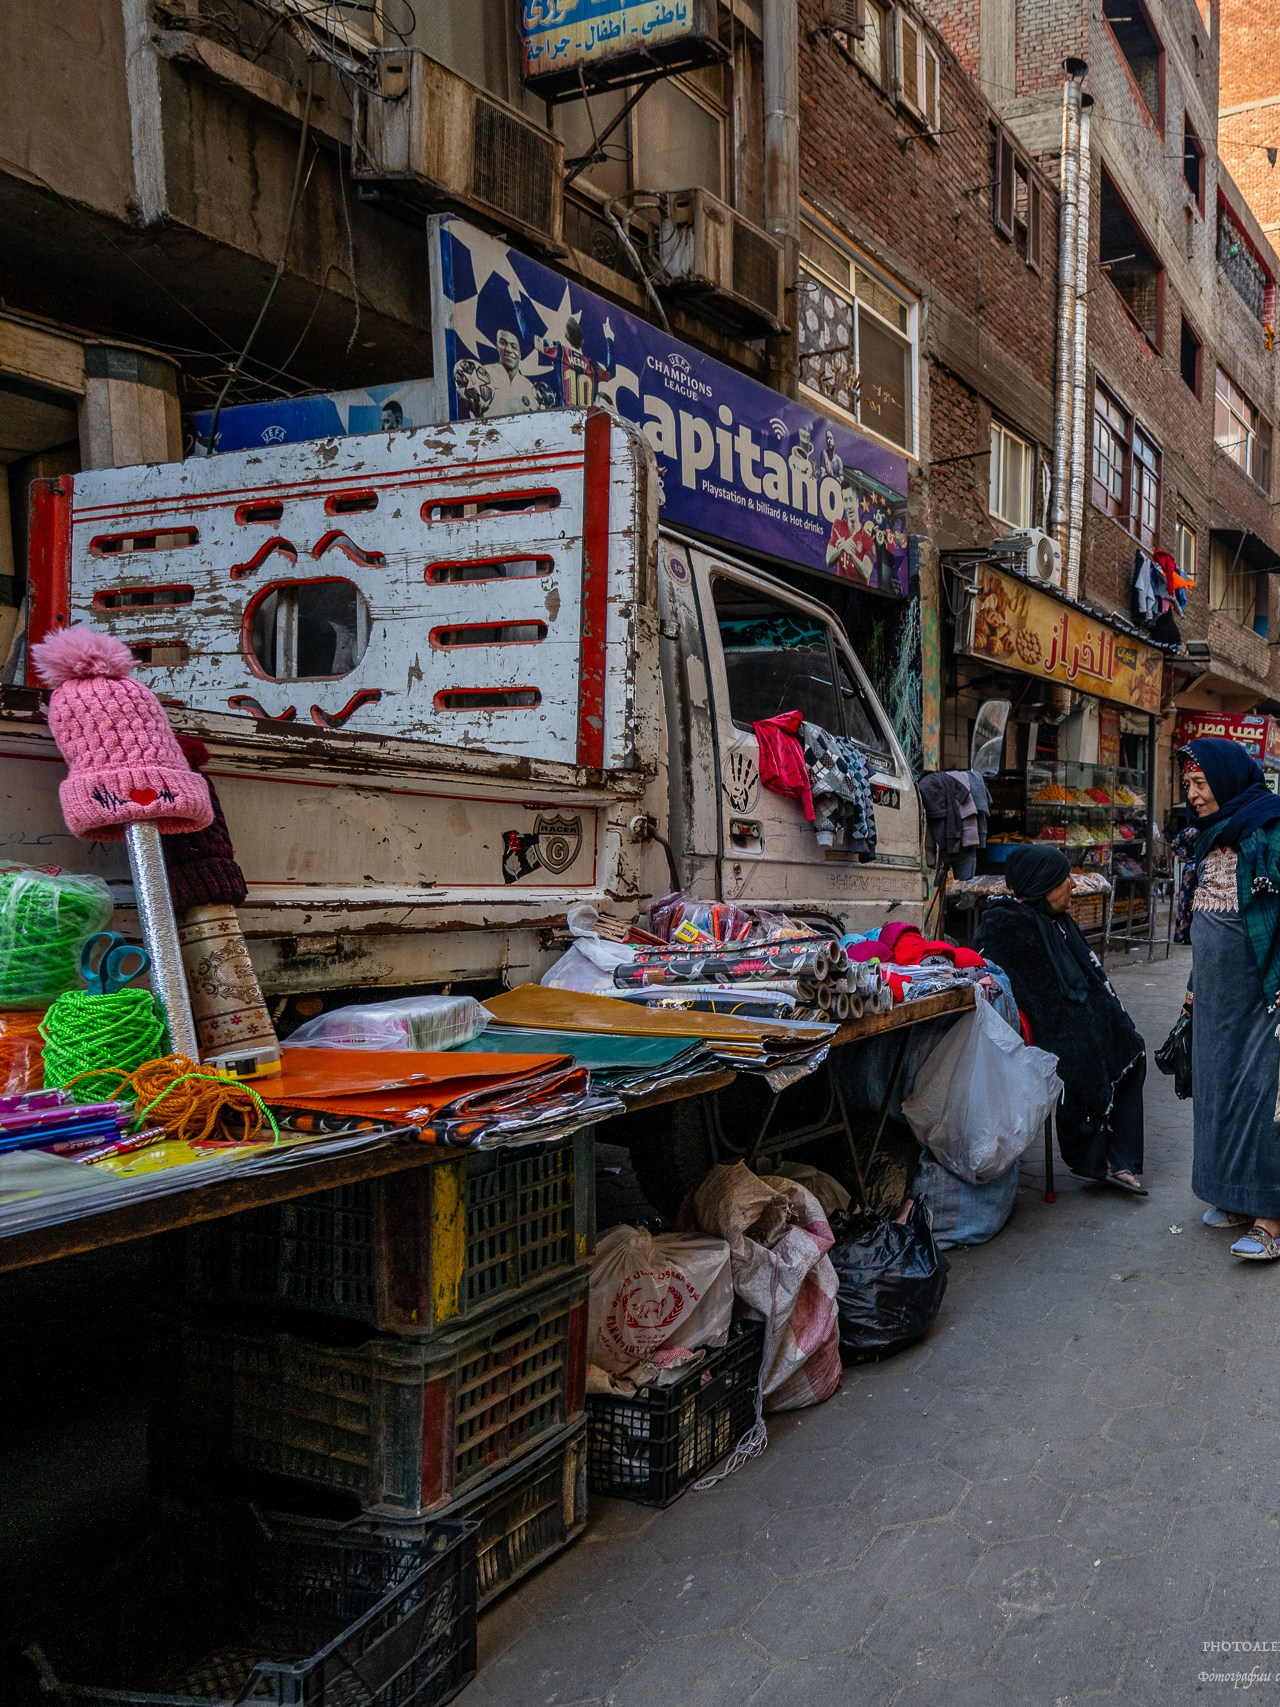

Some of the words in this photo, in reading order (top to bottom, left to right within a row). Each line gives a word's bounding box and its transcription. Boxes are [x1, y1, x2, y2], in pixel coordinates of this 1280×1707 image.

[585, 13, 626, 51] أطفال
[527, 36, 571, 60] جراحة
[668, 354, 692, 375] UEFA
[564, 369, 593, 406] 10
[647, 356, 713, 398] CHAMPIONS
[664, 379, 698, 401] LEAGUE
[261, 426, 287, 444] UEFA
[702, 480, 746, 506] Playstation
[756, 500, 781, 519] billiard
[789, 514, 803, 528] Hot
[804, 520, 824, 535] drinks
[1043, 609, 1116, 684] الخراز
[1195, 722, 1226, 738] مصر
[541, 825, 577, 833] RACER
